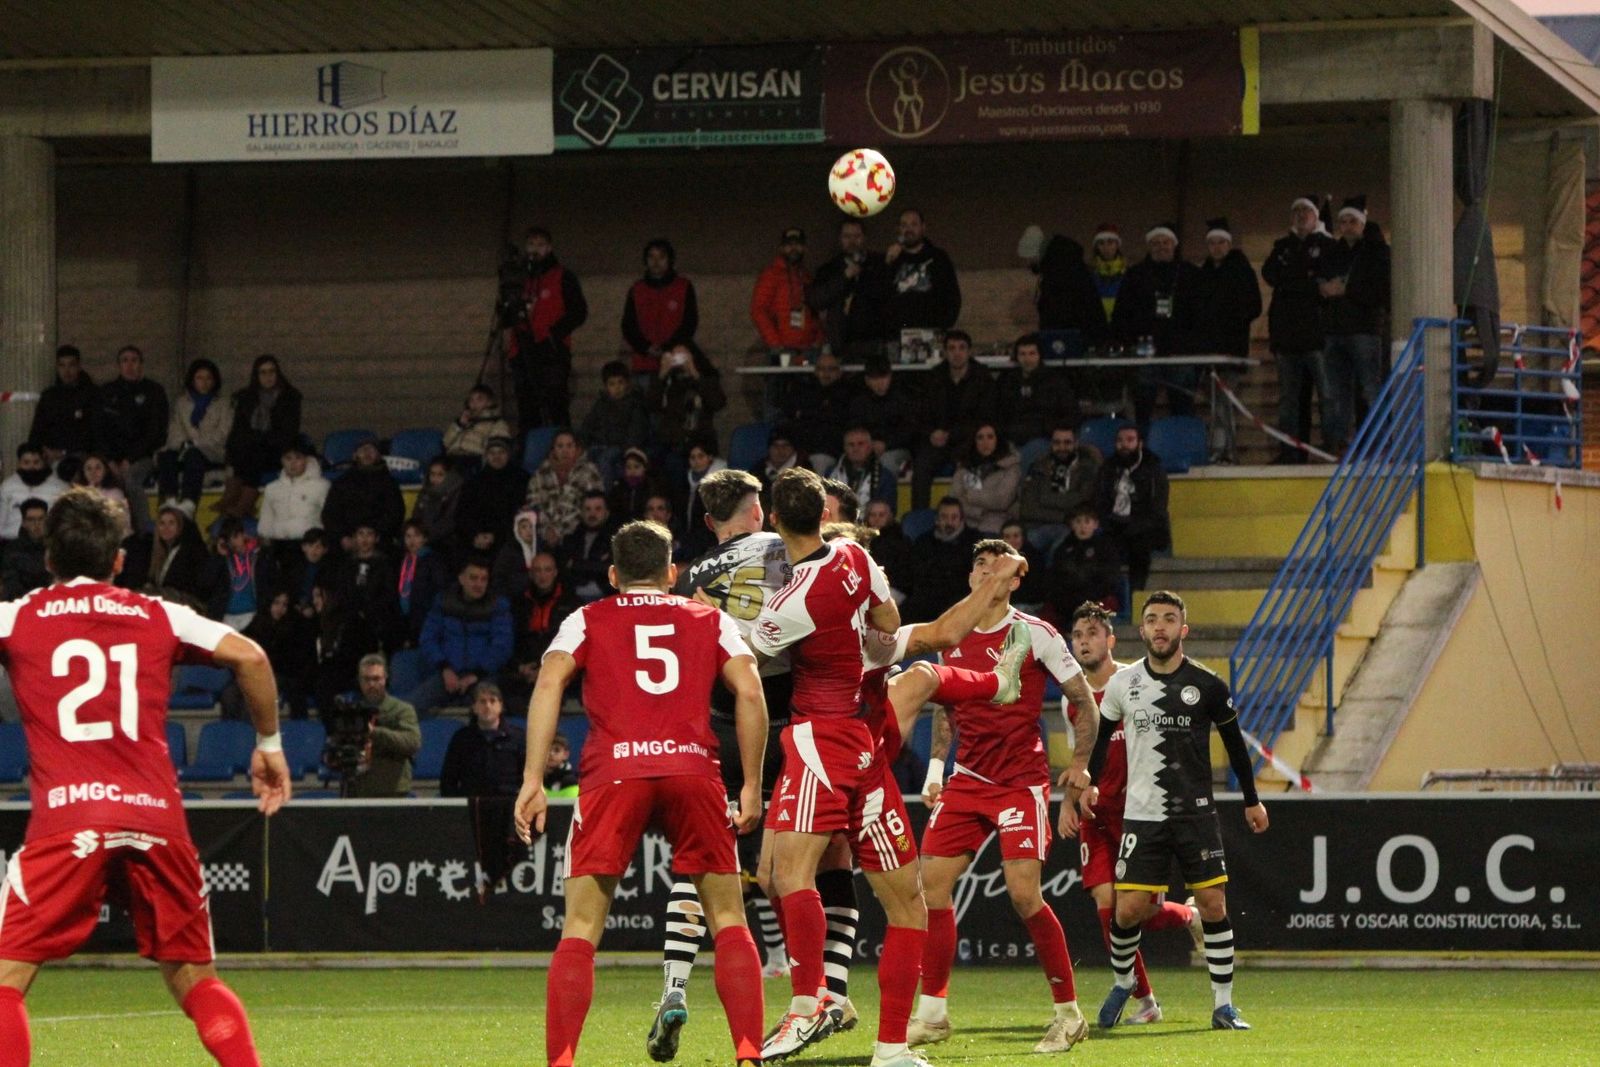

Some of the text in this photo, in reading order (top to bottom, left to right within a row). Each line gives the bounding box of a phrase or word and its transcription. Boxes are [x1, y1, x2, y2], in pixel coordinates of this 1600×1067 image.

[1007, 36, 1116, 56] Embutidos
[652, 68, 801, 100] CERVISÁN
[954, 58, 1184, 102] Jesús Marcos
[1133, 101, 1162, 113] 1930
[247, 105, 459, 138] HIERROS DÍAZ
[37, 596, 91, 618] JOAN
[634, 623, 680, 695] 5
[51, 638, 139, 743] 21
[1154, 715, 1192, 727] Don QR
[1286, 914, 1582, 931] JORGE Y OSCAR CONSTRUCTORA, S.L.
